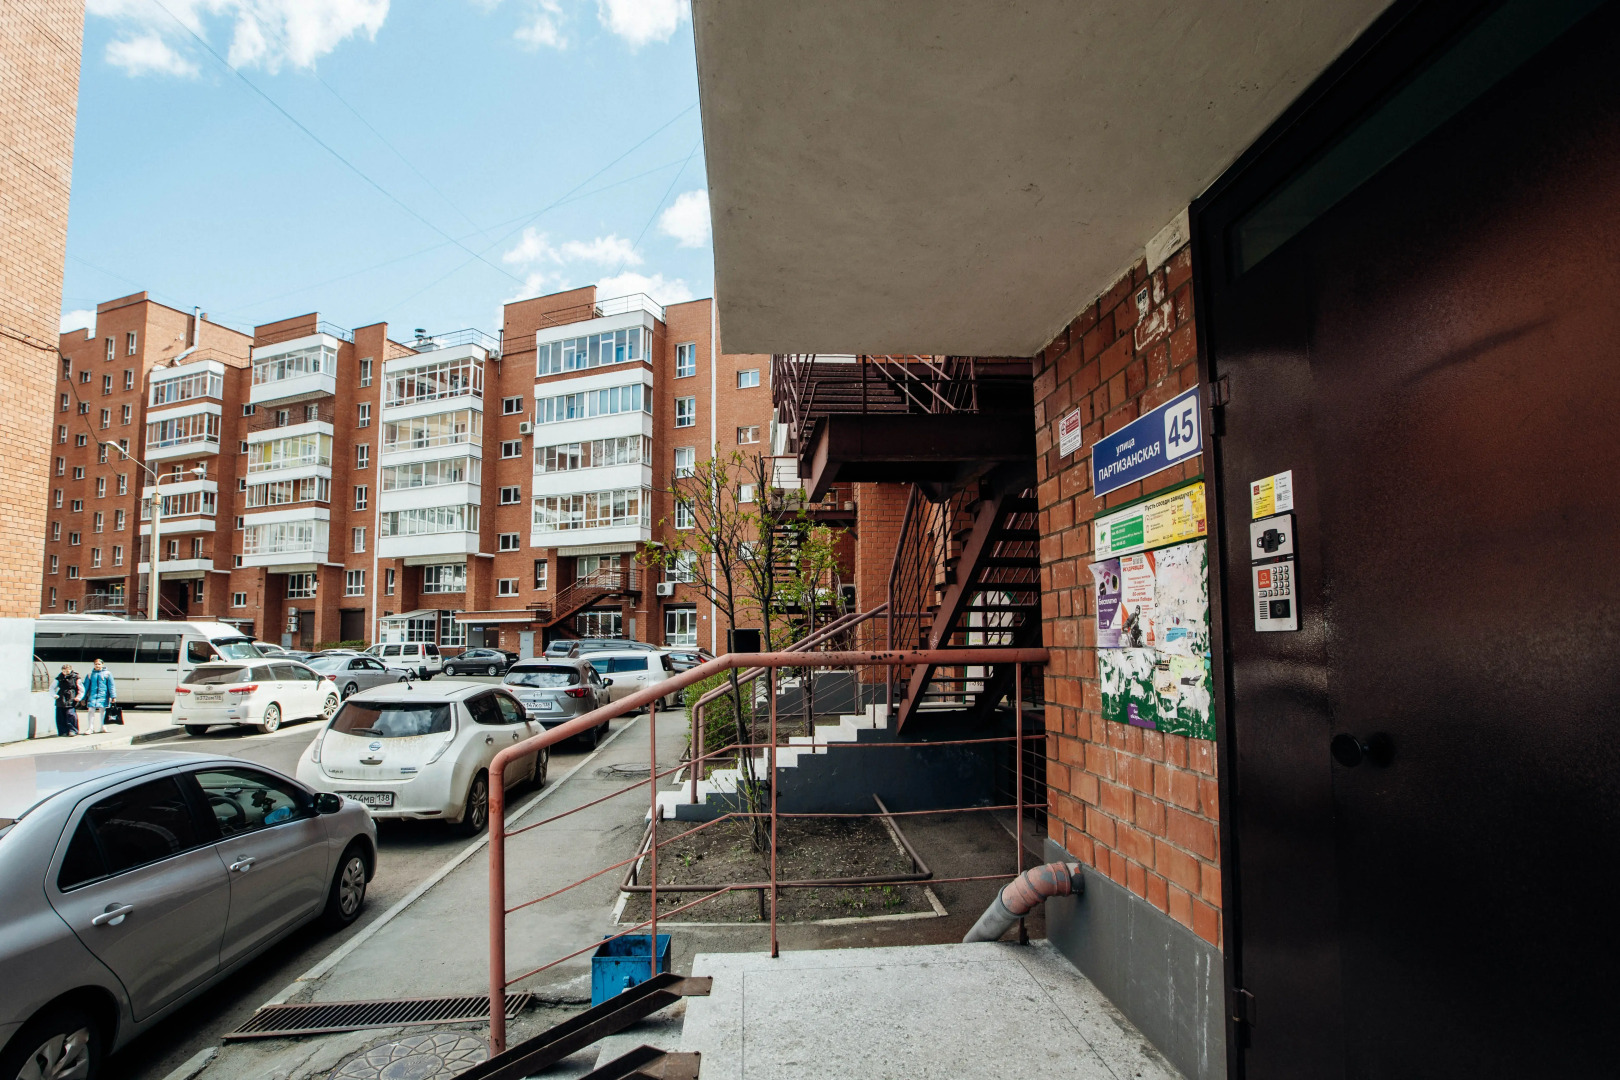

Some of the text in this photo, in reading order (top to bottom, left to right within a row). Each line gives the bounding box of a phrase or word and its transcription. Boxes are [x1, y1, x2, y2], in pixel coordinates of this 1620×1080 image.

[1168, 408, 1193, 447] 45
[1115, 438, 1135, 456] улица
[1098, 441, 1160, 482] ПАРТИЗАНСКАЯ
[1144, 503, 1156, 512] Пусть
[1155, 497, 1170, 508] соседи
[377, 793, 390, 802] 138
